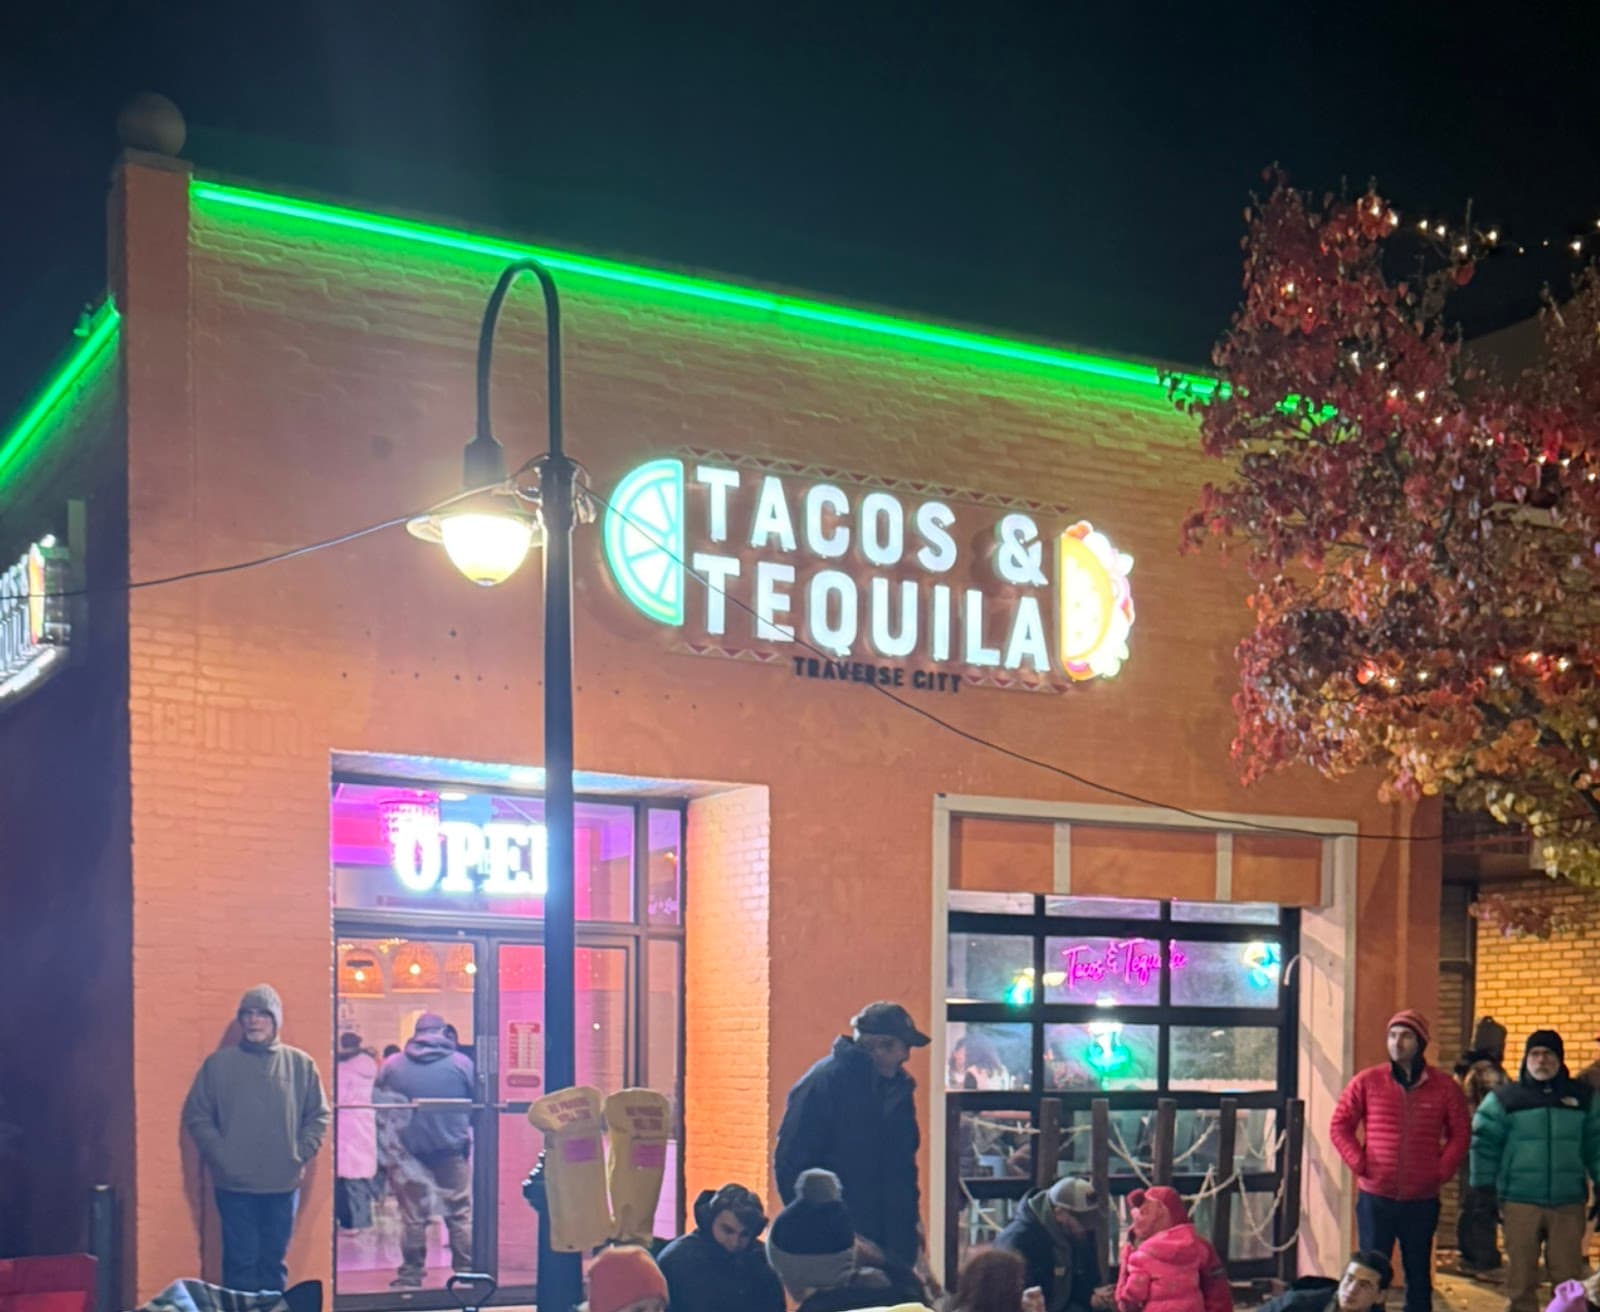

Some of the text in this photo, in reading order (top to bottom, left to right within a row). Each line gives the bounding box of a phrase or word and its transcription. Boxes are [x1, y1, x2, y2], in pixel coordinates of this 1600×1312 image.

[696, 464, 1049, 586] TACOS &
[692, 552, 1051, 673] TEQUILA
[793, 656, 963, 693] TRAVERSE CITY
[392, 821, 547, 894] OPE
[1118, 938, 1187, 985] Tequla
